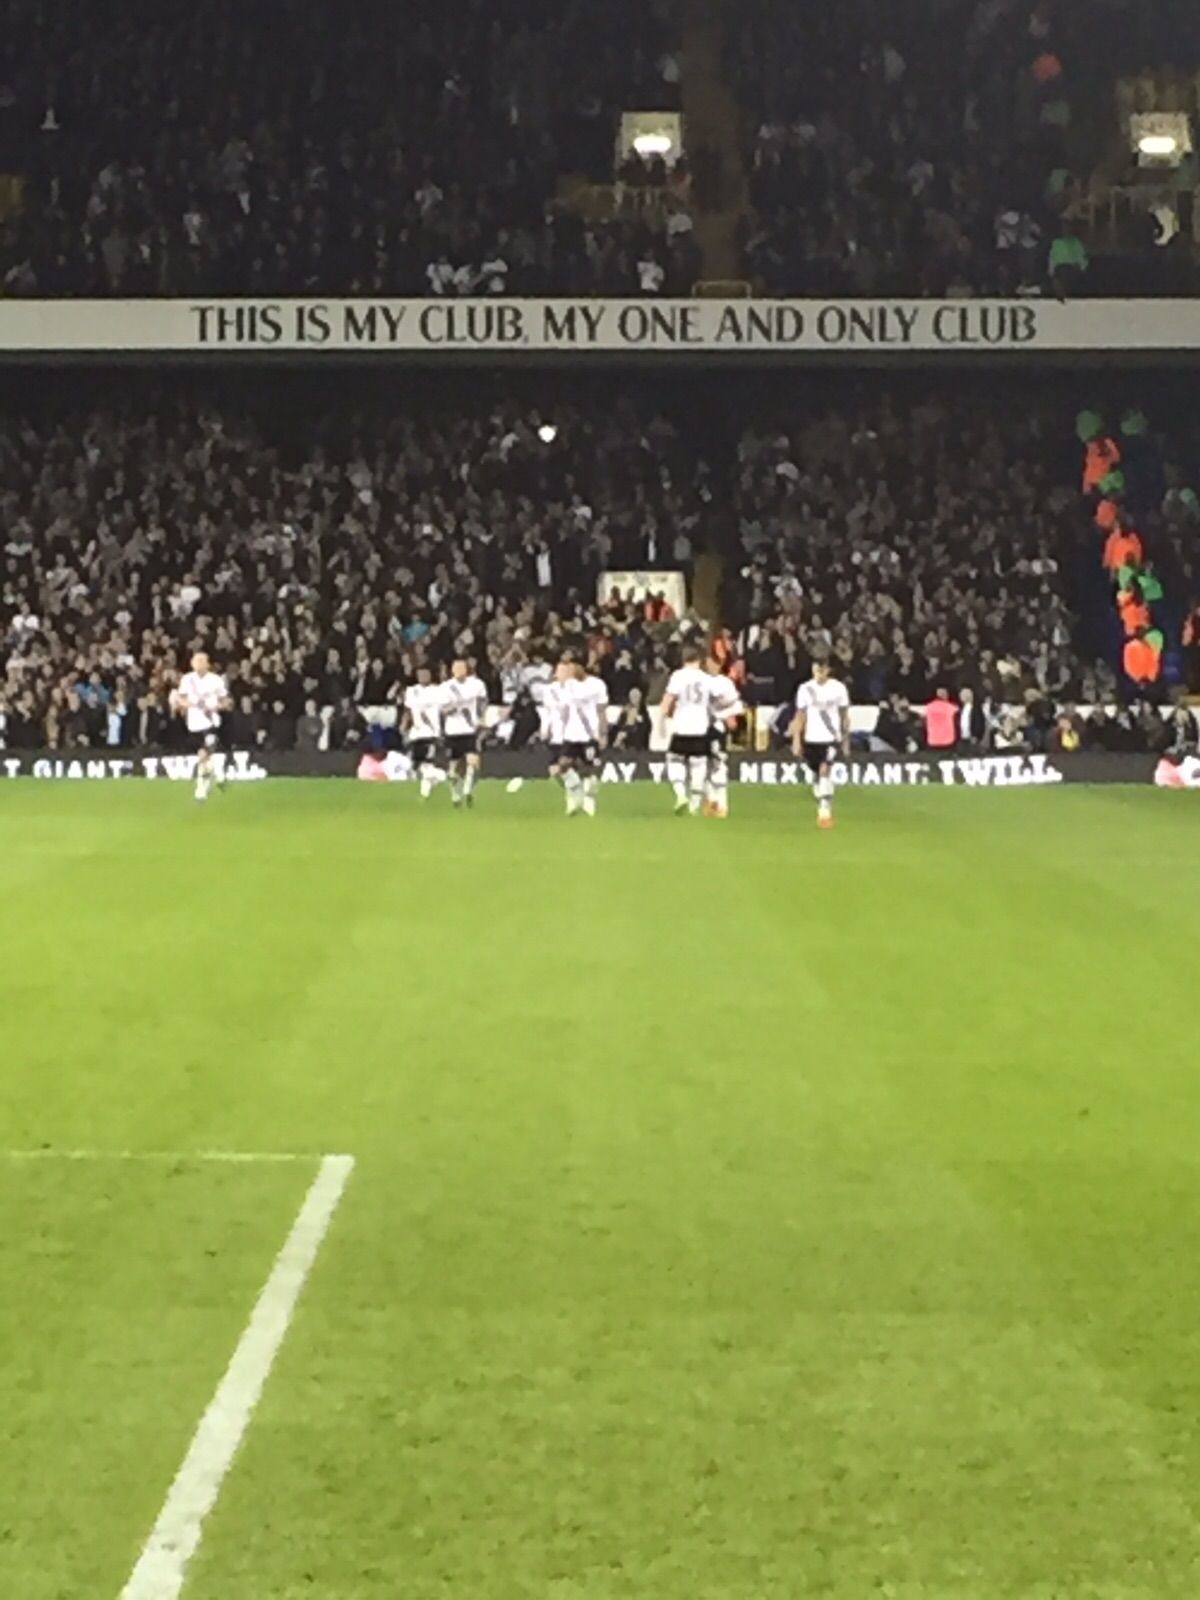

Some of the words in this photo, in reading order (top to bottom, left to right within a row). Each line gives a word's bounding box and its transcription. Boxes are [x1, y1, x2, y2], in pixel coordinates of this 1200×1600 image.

[190, 305, 284, 343] THIS
[295, 305, 331, 343] IS
[343, 305, 406, 343] MY
[542, 305, 606, 343] MY
[617, 305, 704, 343] ONE
[714, 305, 804, 343] AND
[816, 305, 919, 343] ONLY
[932, 305, 1038, 343] CLUB
[686, 682, 703, 704] 15
